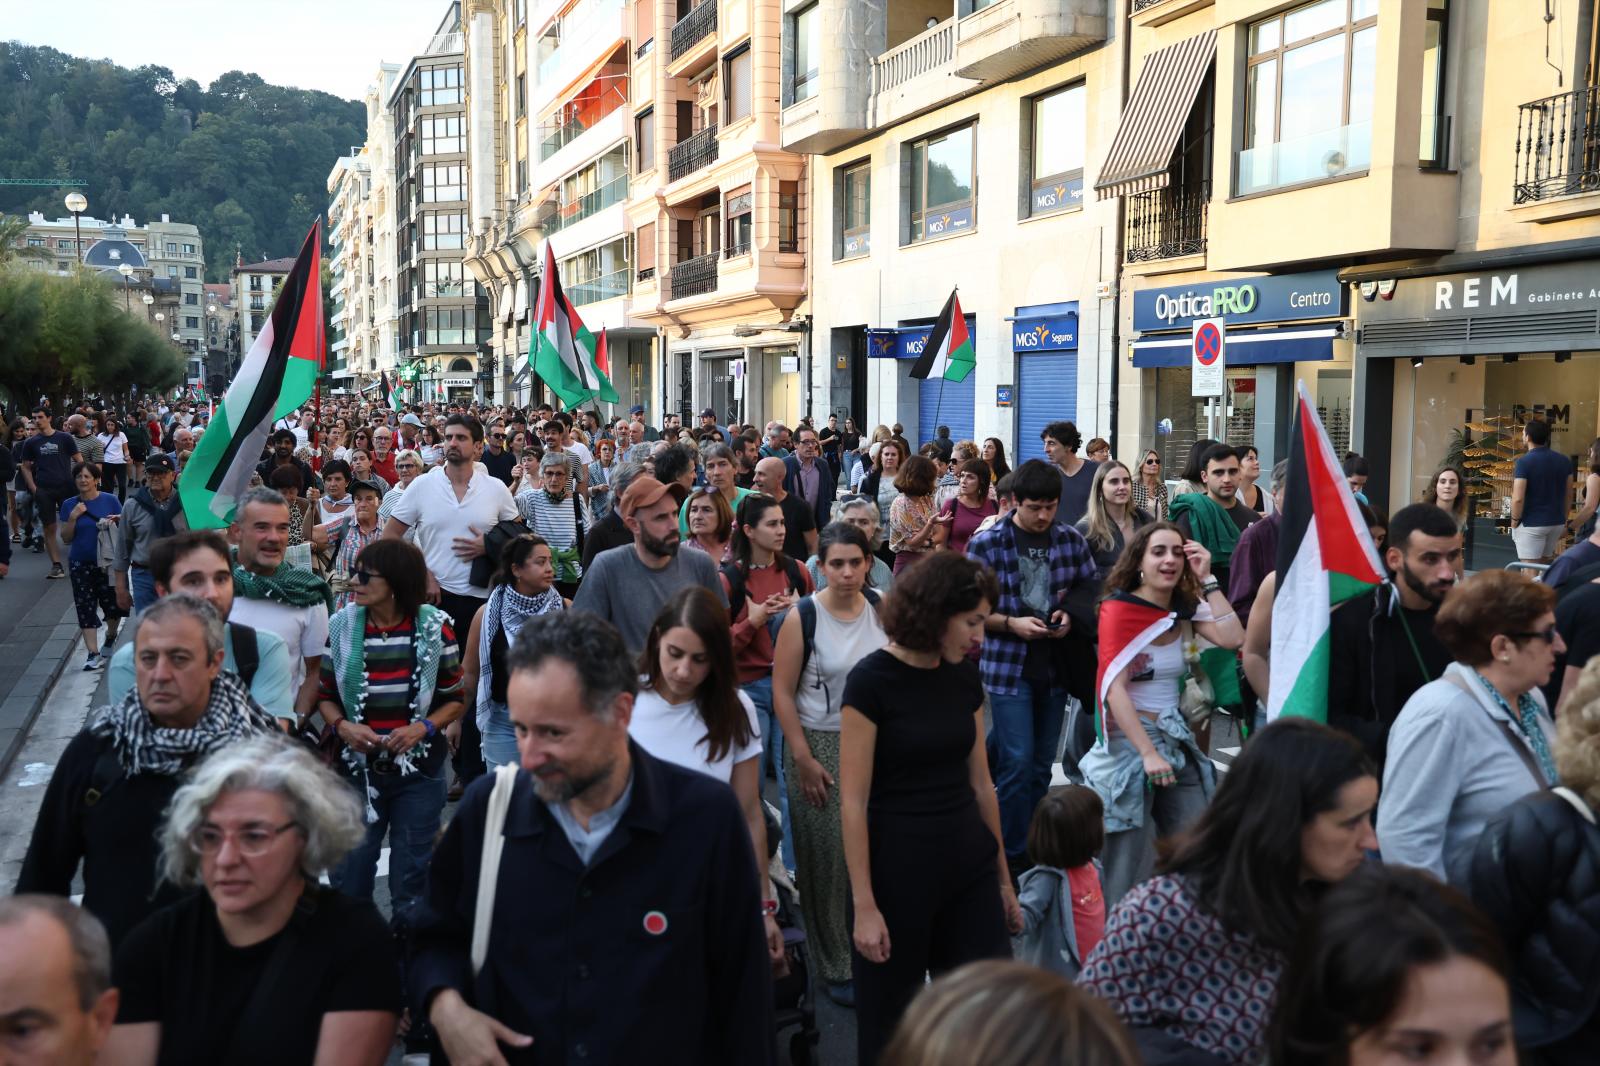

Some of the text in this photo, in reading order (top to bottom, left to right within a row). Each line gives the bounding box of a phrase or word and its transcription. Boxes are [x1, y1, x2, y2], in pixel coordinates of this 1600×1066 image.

[1037, 193, 1056, 208] MGS
[929, 220, 944, 233] MGS
[1290, 290, 1331, 308] Centro
[1435, 274, 1519, 311] REM
[1528, 290, 1583, 304] Gabinete
[906, 339, 923, 354] MGS
[1015, 331, 1074, 347] MGS Seguros
